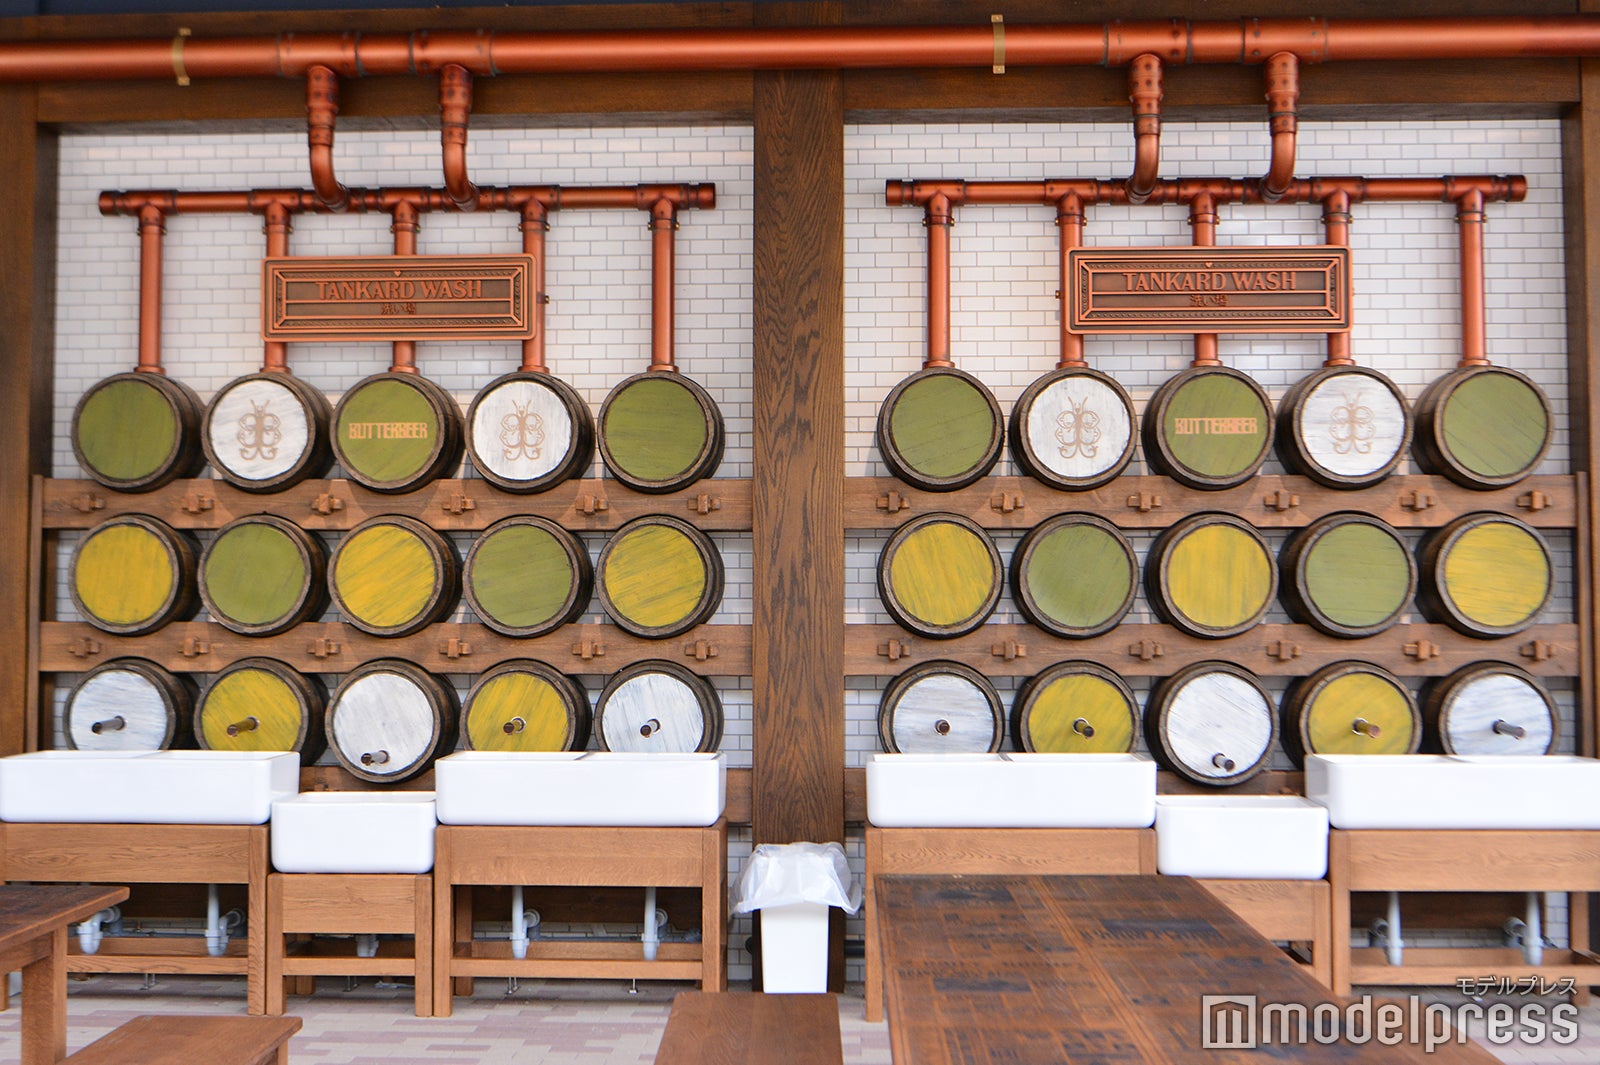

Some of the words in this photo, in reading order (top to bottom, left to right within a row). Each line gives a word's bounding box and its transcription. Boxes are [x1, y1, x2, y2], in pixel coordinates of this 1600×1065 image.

[316, 280, 415, 299] TANKARD
[419, 279, 482, 299] WASH
[1122, 272, 1227, 291] TANKARD
[1231, 271, 1297, 290] WASH
[349, 422, 428, 439] BUTTERBEER
[1175, 417, 1257, 434] BUTTERBEER
